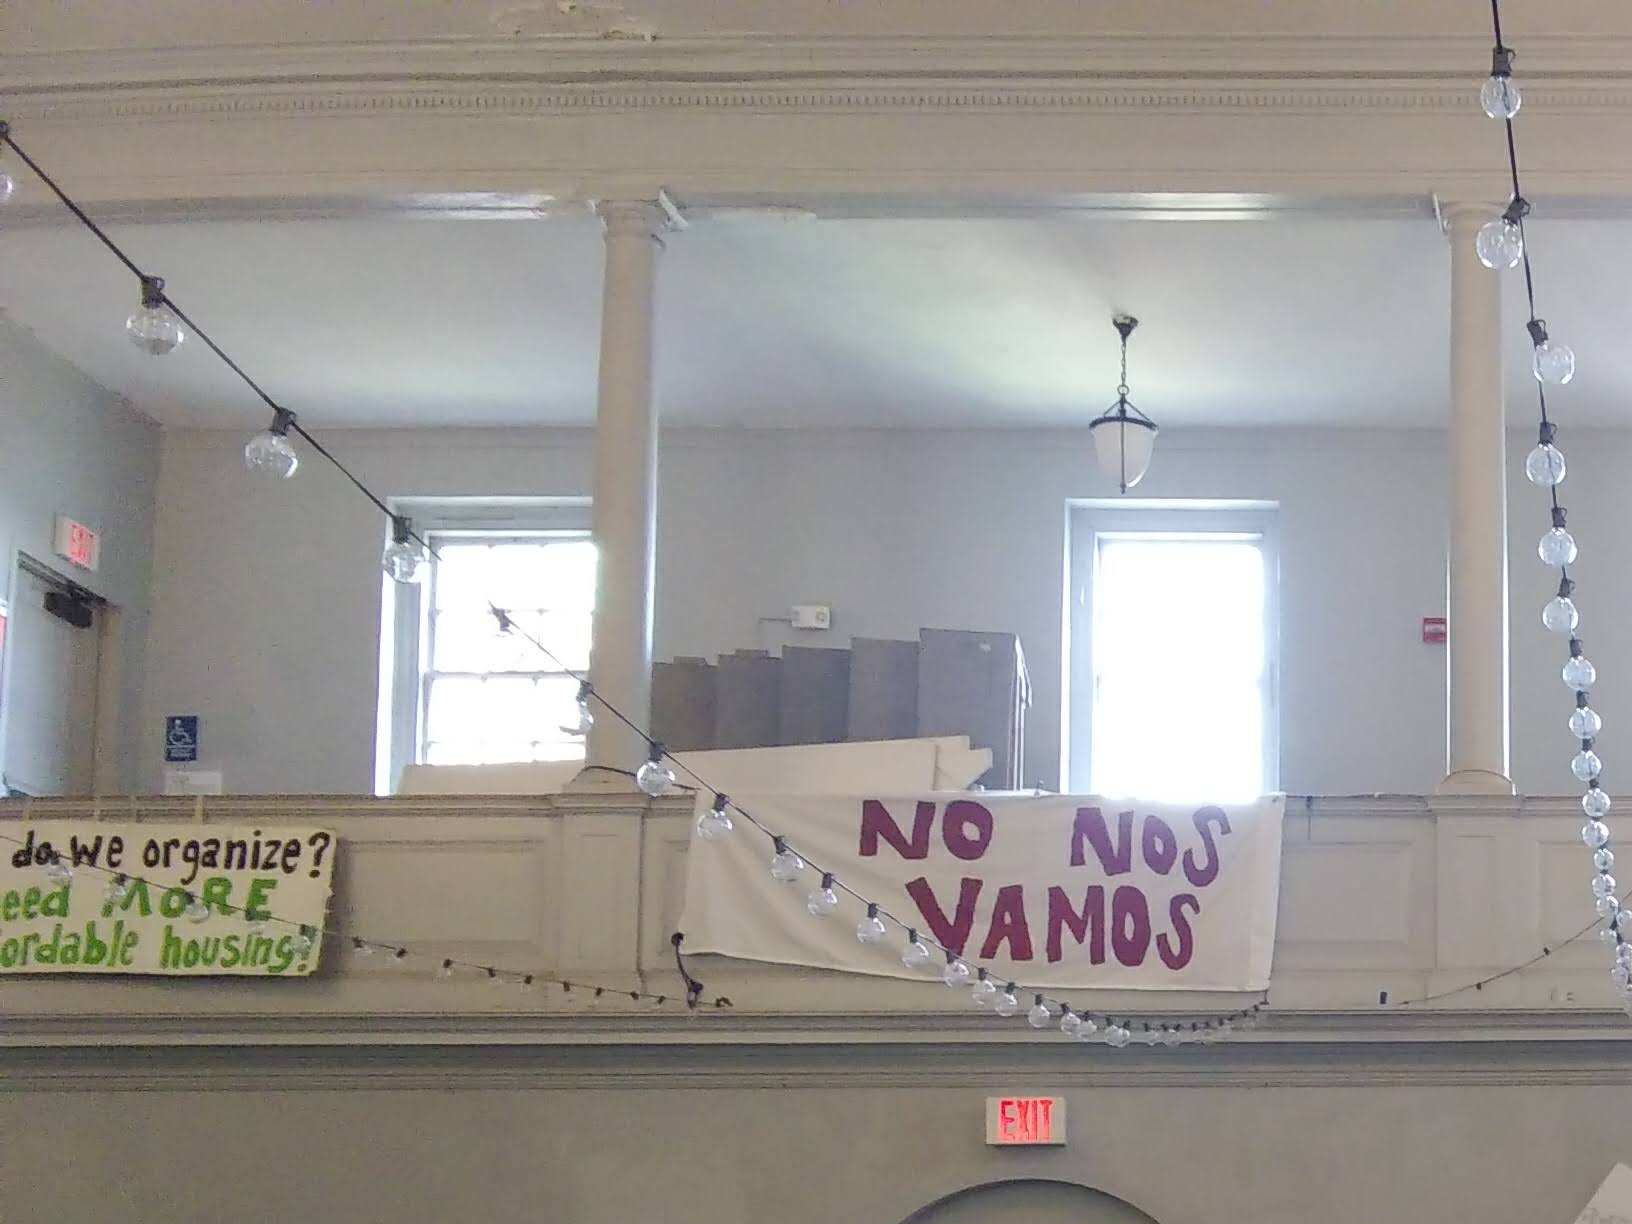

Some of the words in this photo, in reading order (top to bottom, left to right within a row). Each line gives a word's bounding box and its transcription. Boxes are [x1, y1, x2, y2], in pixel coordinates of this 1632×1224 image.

[11, 830, 60, 868] do
[70, 835, 124, 868] we
[142, 830, 331, 885] organize?
[858, 800, 993, 860] NO
[1070, 805, 1232, 888] NOS
[101, 876, 278, 922] MORE
[905, 877, 1200, 970] VAMOS
[159, 924, 319, 974] housing!
[1000, 1099, 1053, 1141] EXIT
